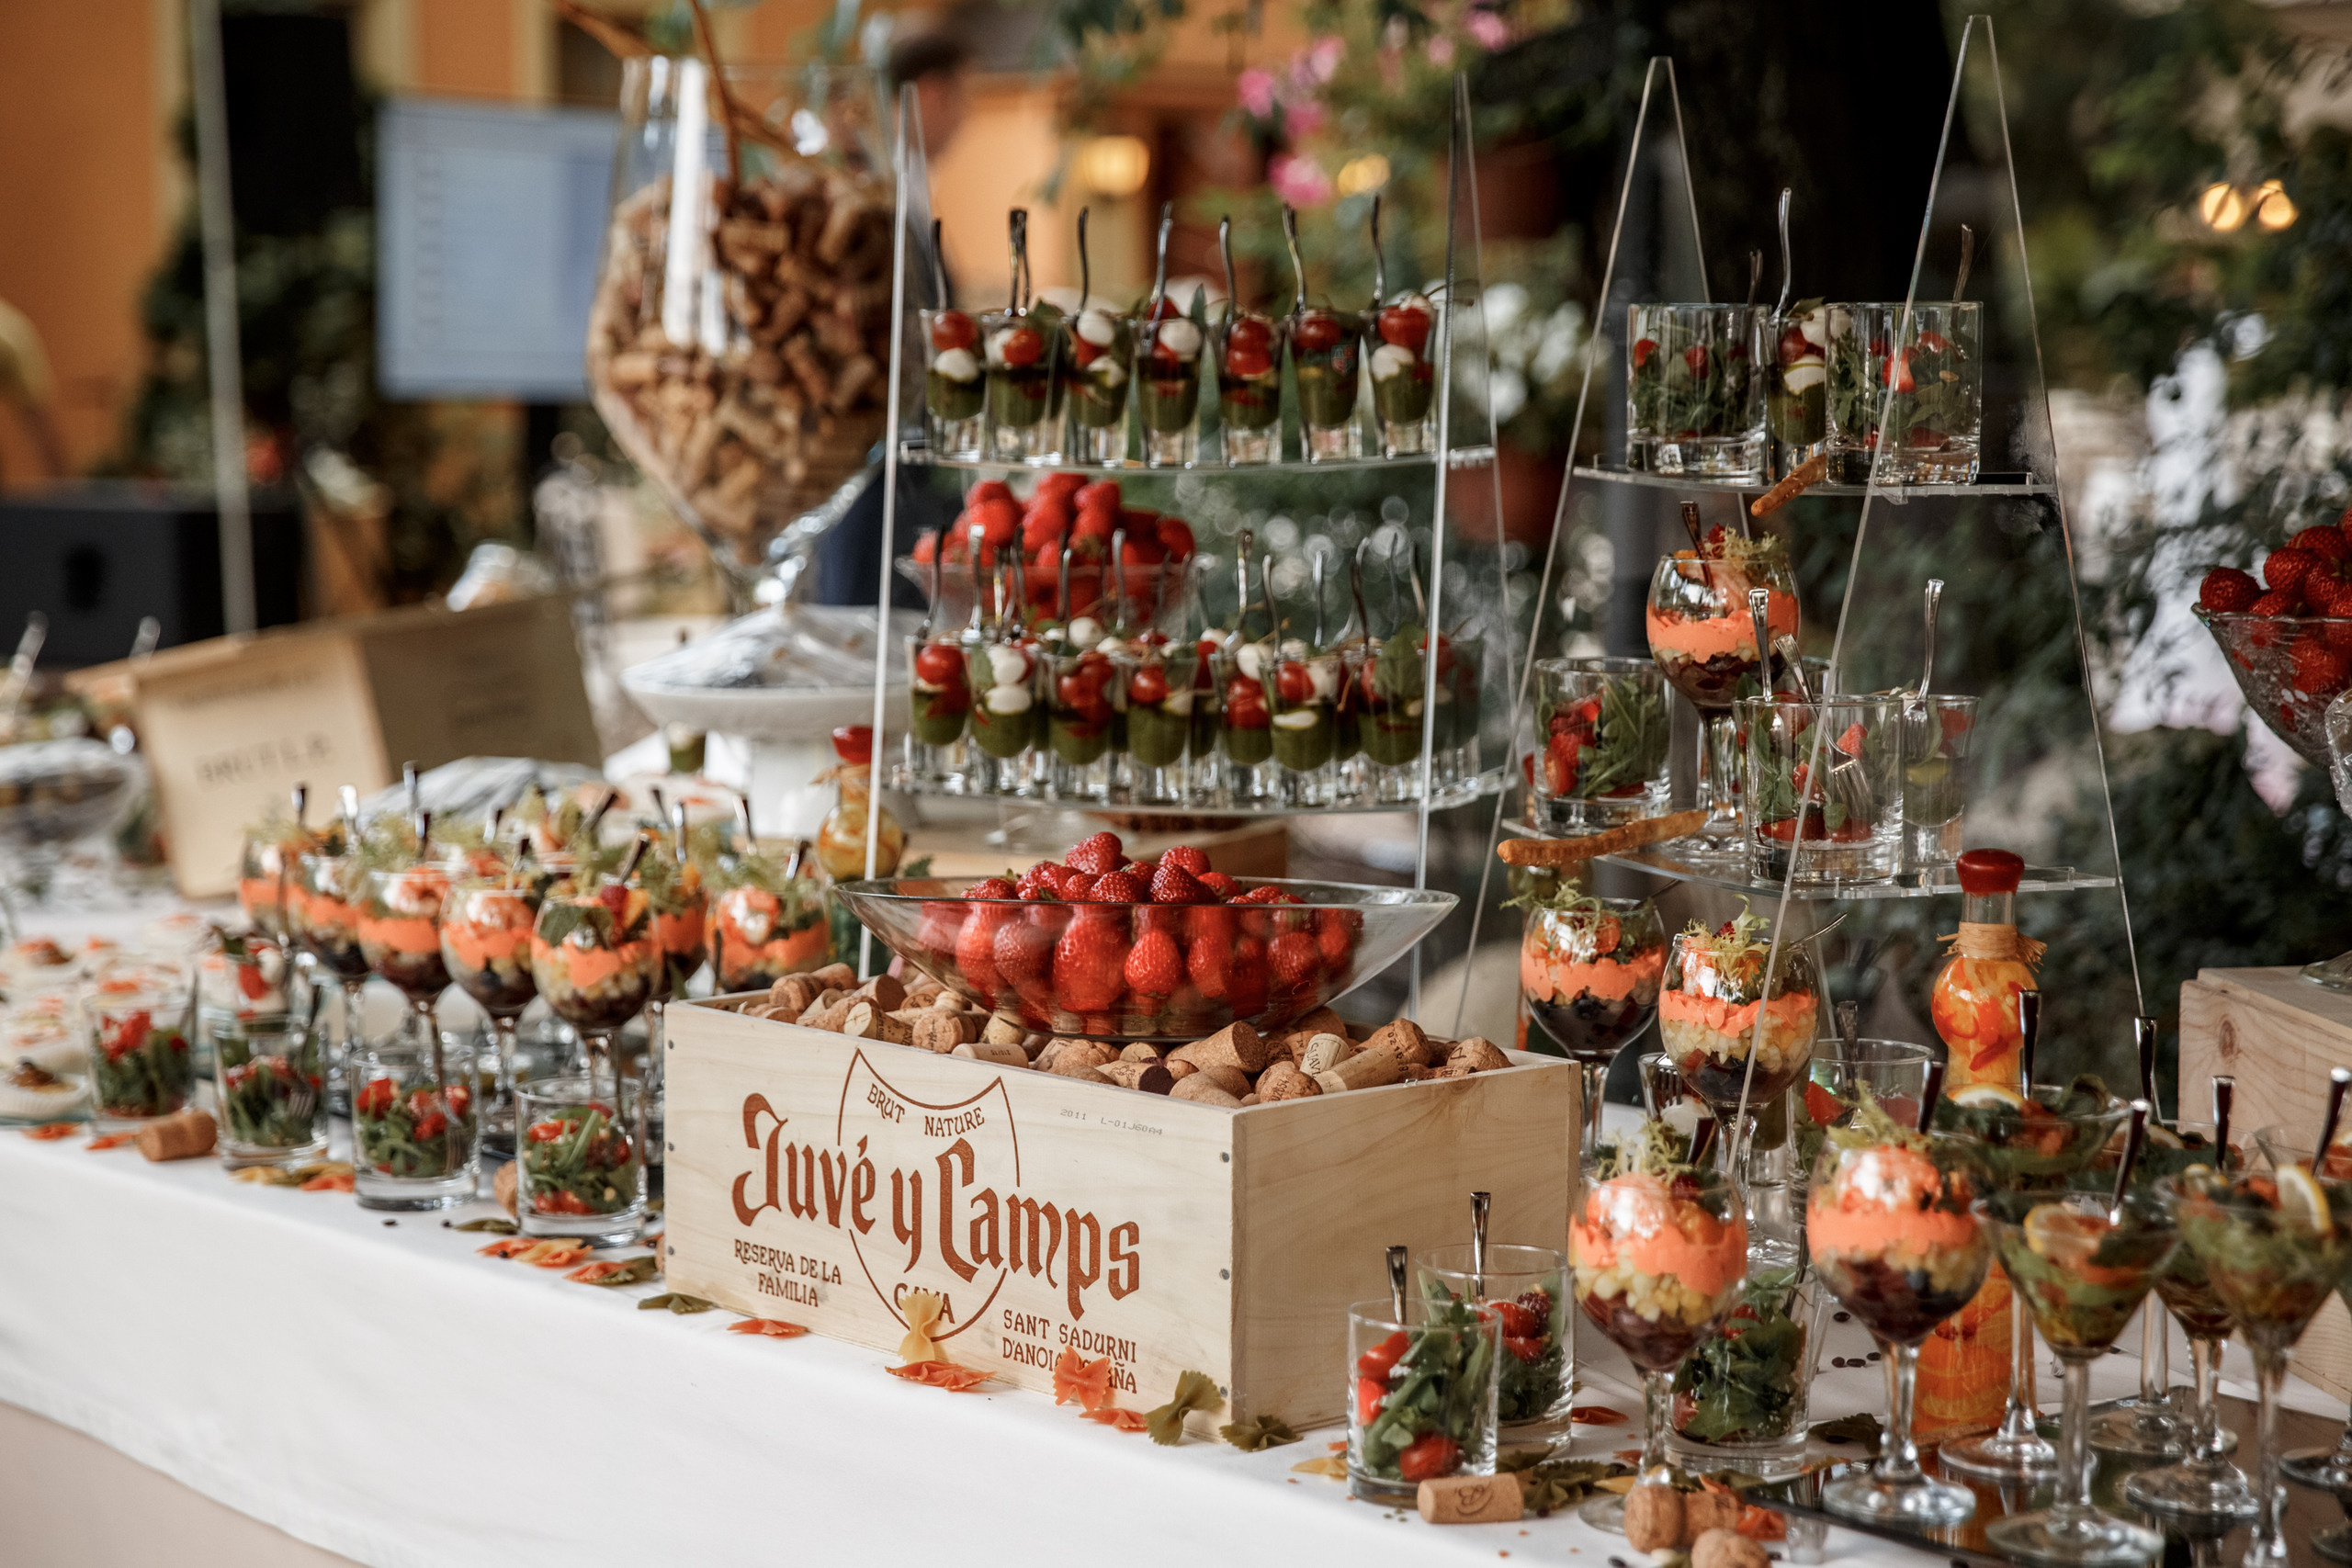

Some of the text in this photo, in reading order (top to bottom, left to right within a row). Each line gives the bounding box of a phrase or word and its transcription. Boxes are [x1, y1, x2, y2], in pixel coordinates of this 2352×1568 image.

[867, 1083, 985, 1137] BRUT NATURE
[1060, 1109, 1087, 1121] 2011
[732, 1092, 1140, 1322] Juvé y Camps
[734, 1238, 842, 1285] RESERVA DE LA
[758, 1272, 819, 1307] FAMILIA
[894, 1282, 956, 1325] CA
[1003, 1309, 1136, 1364] SANT SADURNI
